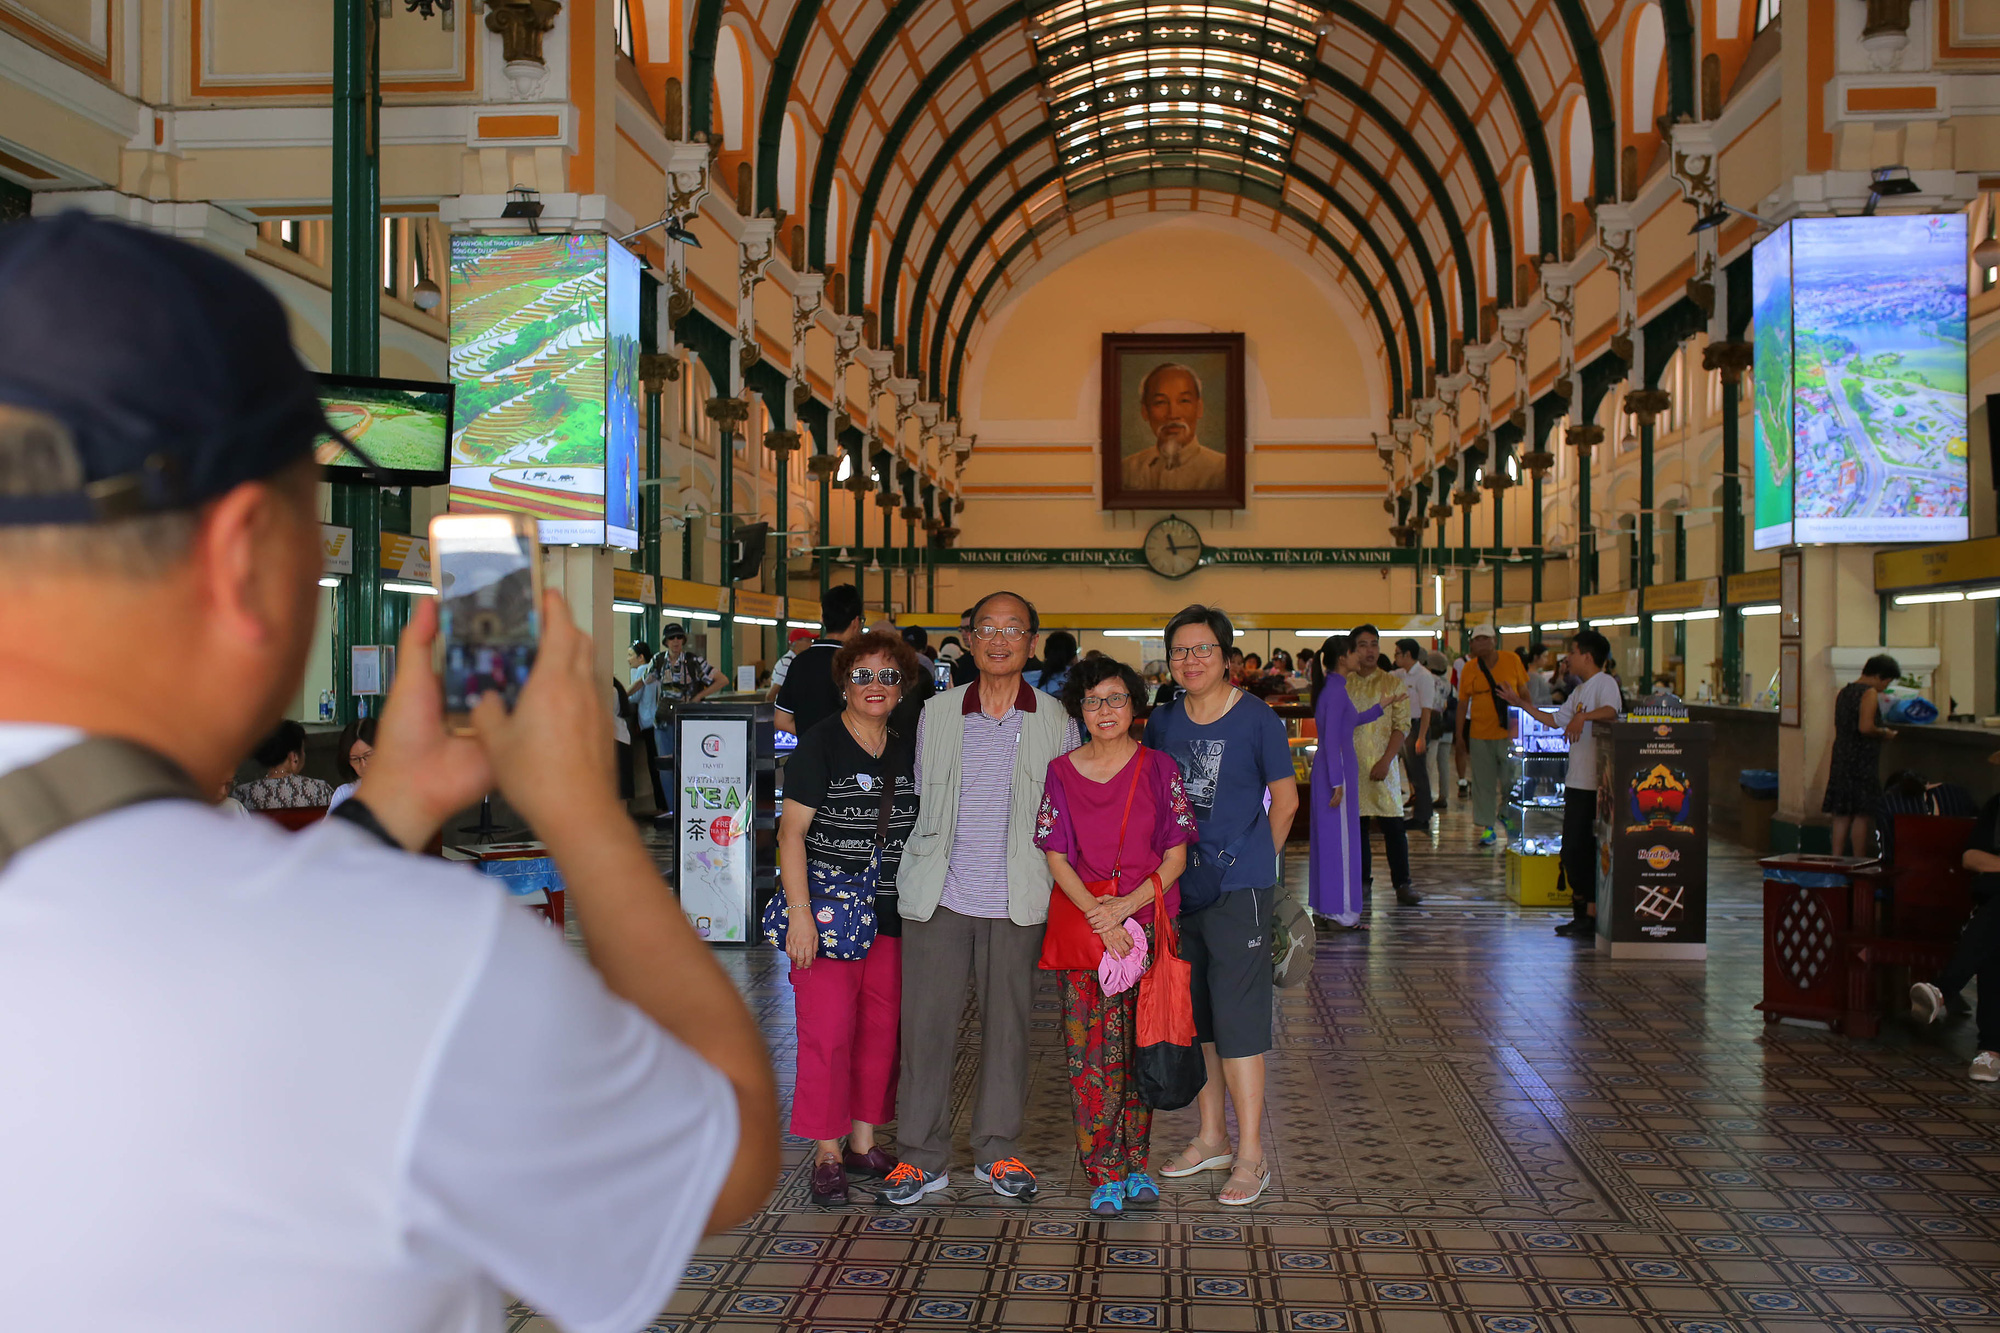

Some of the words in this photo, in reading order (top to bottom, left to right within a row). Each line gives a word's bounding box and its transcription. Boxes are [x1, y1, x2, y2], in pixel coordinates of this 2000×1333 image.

[959, 552, 1001, 562] NHANH
[1005, 550, 1047, 562] CHÓNG
[1062, 550, 1103, 562] CHÍNH
[1107, 550, 1134, 562] XÁC
[1233, 550, 1264, 562] TOÀN
[1272, 550, 1301, 564] TIỆN
[1303, 550, 1323, 564] LỢI
[1332, 550, 1357, 562] VĂN
[1359, 551, 1391, 562] MINH
[685, 786, 741, 810] TEA
[686, 818, 706, 841] 茶
[1638, 849, 1659, 859] Hard
[1660, 849, 1680, 861] Rock
